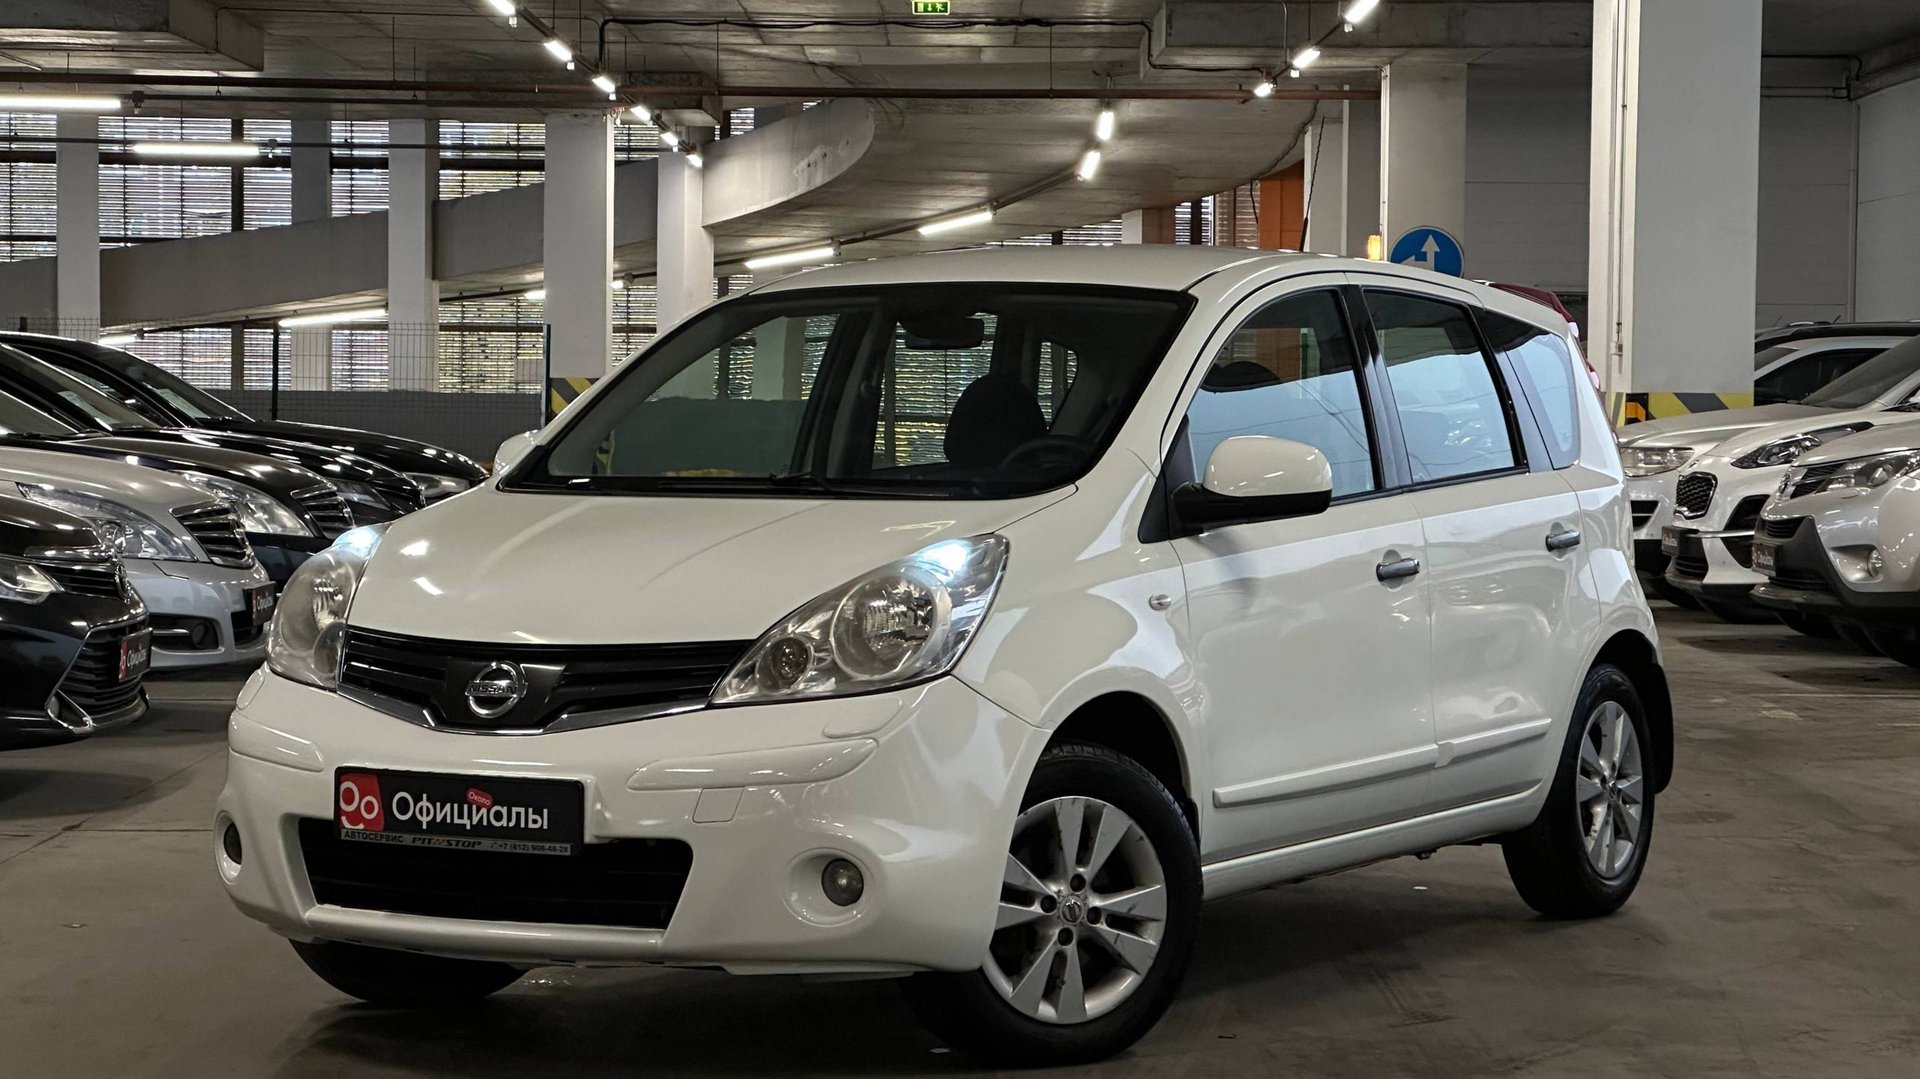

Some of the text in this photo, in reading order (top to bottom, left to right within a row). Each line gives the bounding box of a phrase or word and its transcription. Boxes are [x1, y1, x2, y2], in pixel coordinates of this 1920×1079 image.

[468, 684, 517, 694] NISSAN
[392, 791, 549, 830] Официалы
[344, 830, 404, 843] АВТОСЕРВИС
